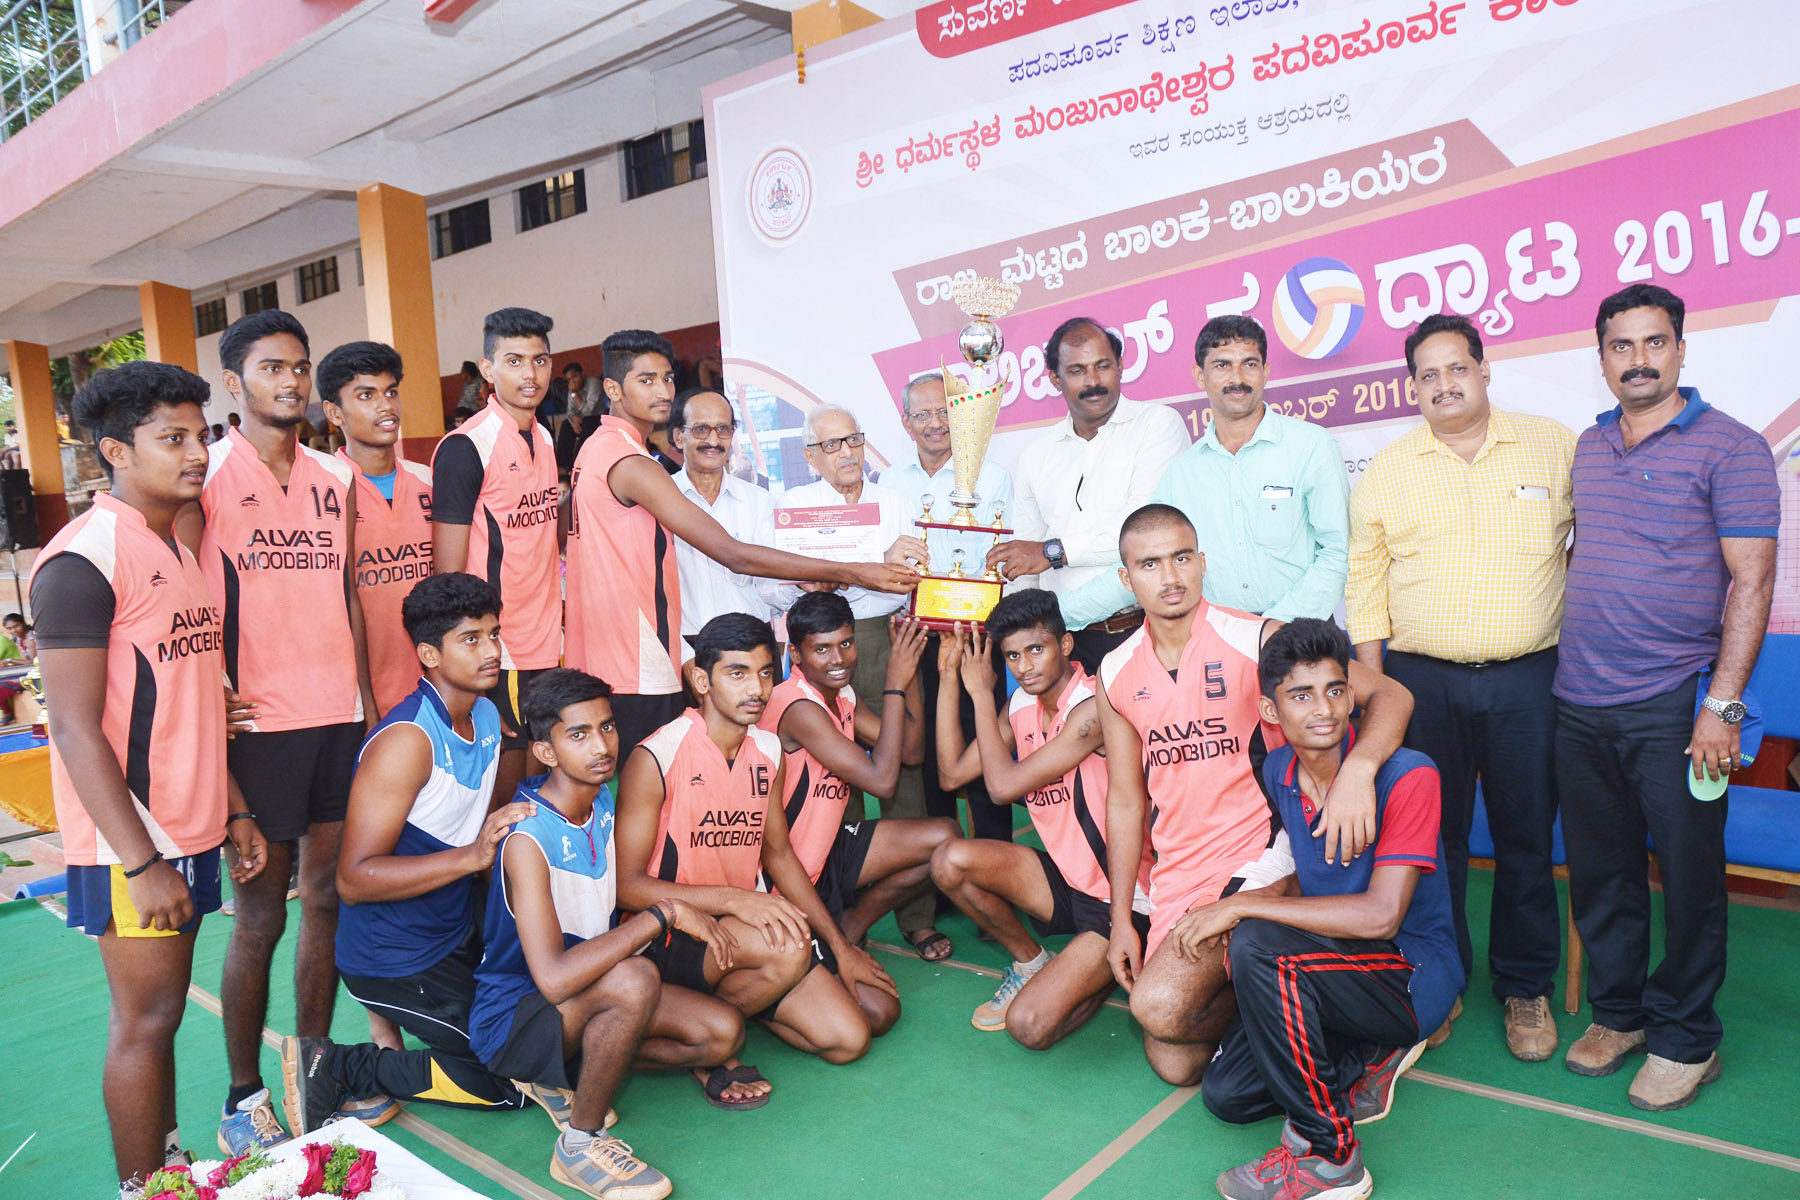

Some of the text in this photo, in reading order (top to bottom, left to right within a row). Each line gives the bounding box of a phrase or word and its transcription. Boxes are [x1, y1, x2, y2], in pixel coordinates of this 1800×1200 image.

[1008, 33, 1129, 83] ಪದವಿಪೂರ್ವ
[1142, 15, 1196, 53] ಶಿಕ್ಷಣ
[856, 150, 884, 188] ಶ್ರೀ
[895, 114, 1001, 173] ಧರ್ಮಸ್ಥಳ
[1014, 53, 1235, 139] ಮಂಜುನಾಥೇಶ್ವರ
[1252, 1, 1466, 82] ಪದವಿಪೂರ್ವ
[1129, 92, 1352, 158] ಇವರ ಸಂಯುಕ್ತ ಆಶ್ರಯದಲ್ಲಿ
[310, 484, 341, 520] 14
[247, 529, 333, 548] ALVA'S
[356, 541, 433, 568] ALVA'S
[238, 551, 340, 571] MOODBIDRI
[1204, 660, 1228, 701] 5
[1148, 716, 1228, 747] ALVA'S
[748, 763, 769, 799] 16
[698, 810, 763, 827] ALVA'S
